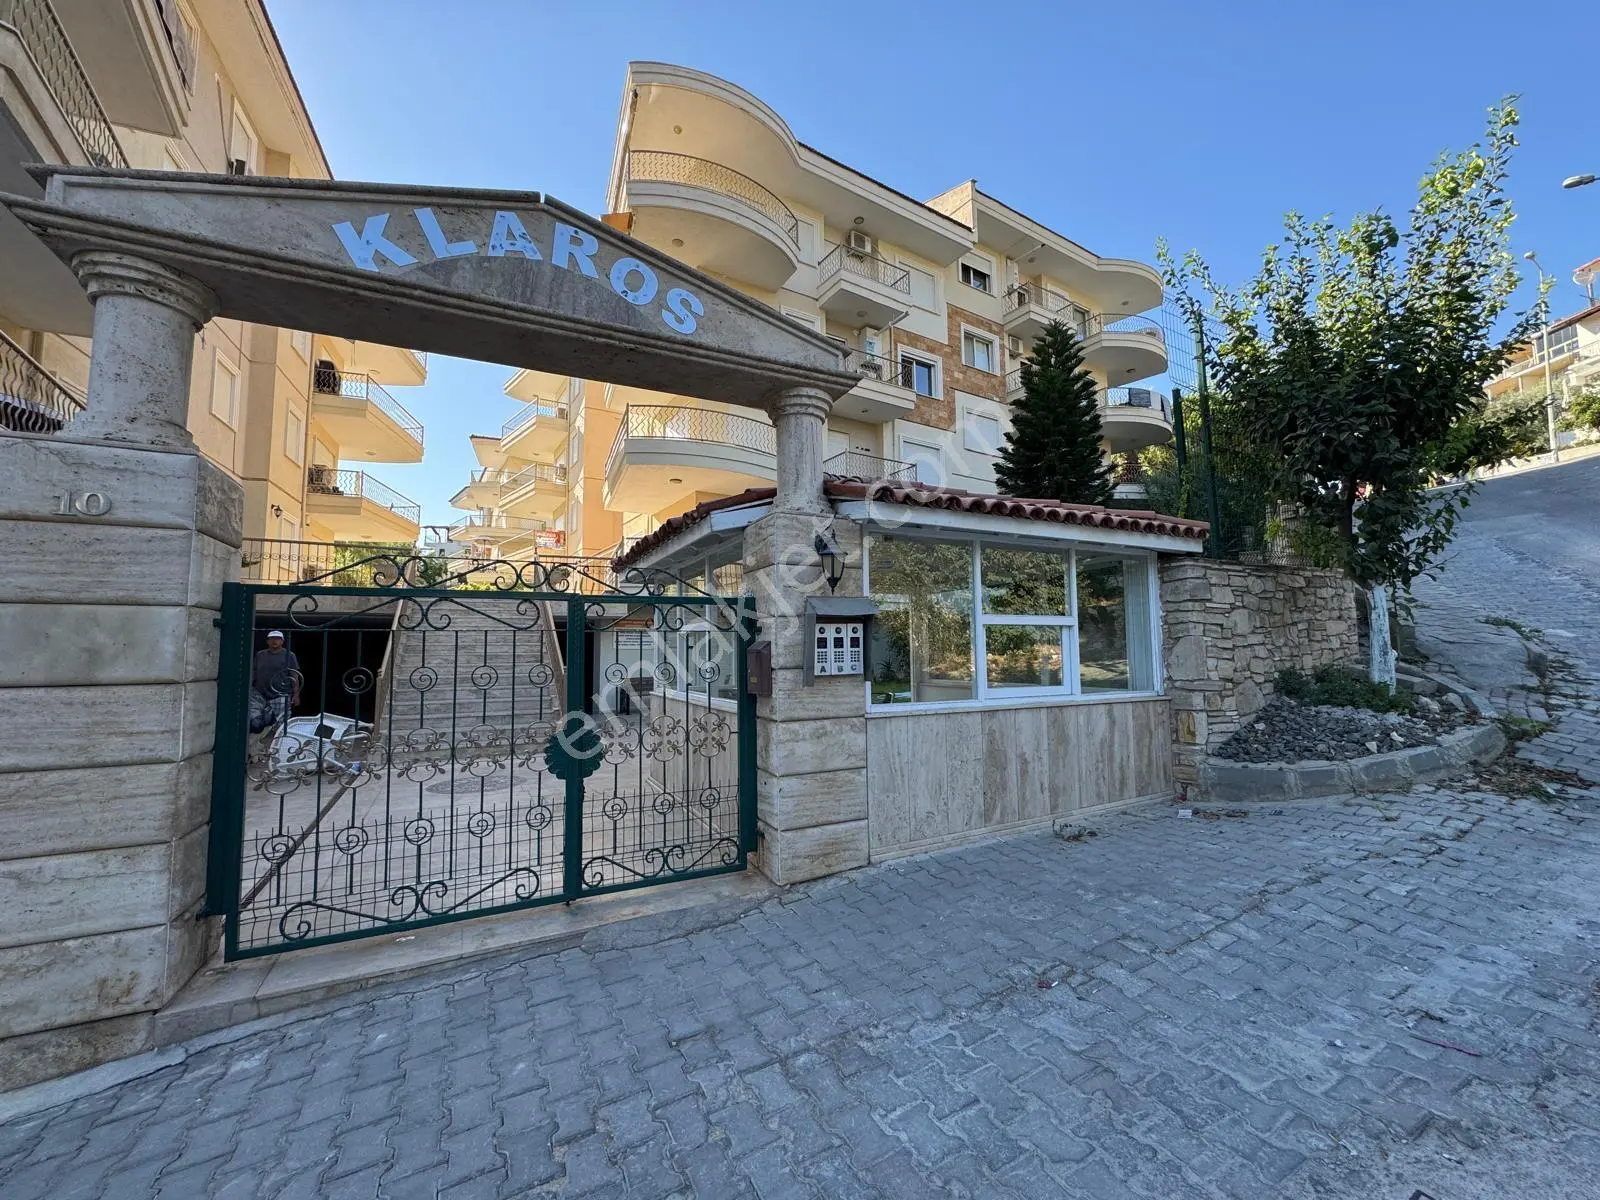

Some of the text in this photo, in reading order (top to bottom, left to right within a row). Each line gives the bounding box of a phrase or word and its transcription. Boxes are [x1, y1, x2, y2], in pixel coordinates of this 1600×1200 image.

[332, 207, 705, 336] KLAROS
[52, 488, 113, 517] 10
[819, 665, 827, 673] A
[837, 665, 844, 673] B
